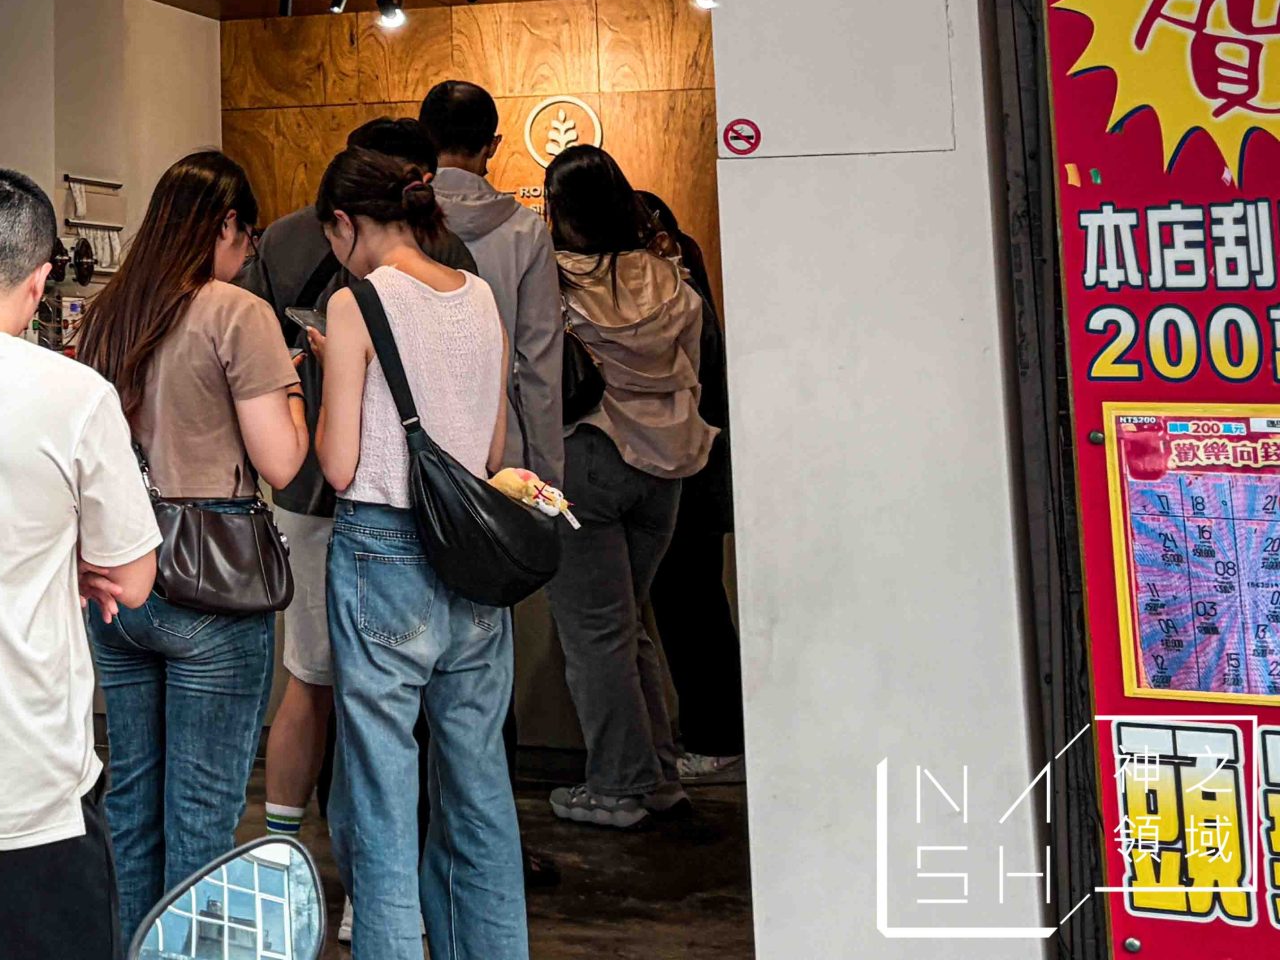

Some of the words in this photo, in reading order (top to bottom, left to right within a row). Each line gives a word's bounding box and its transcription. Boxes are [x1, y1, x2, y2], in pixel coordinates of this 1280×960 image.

[519, 186, 544, 198] RO
[1086, 303, 1280, 384] 200
[1215, 560, 1237, 577] 08
[1195, 600, 1218, 617] 03
